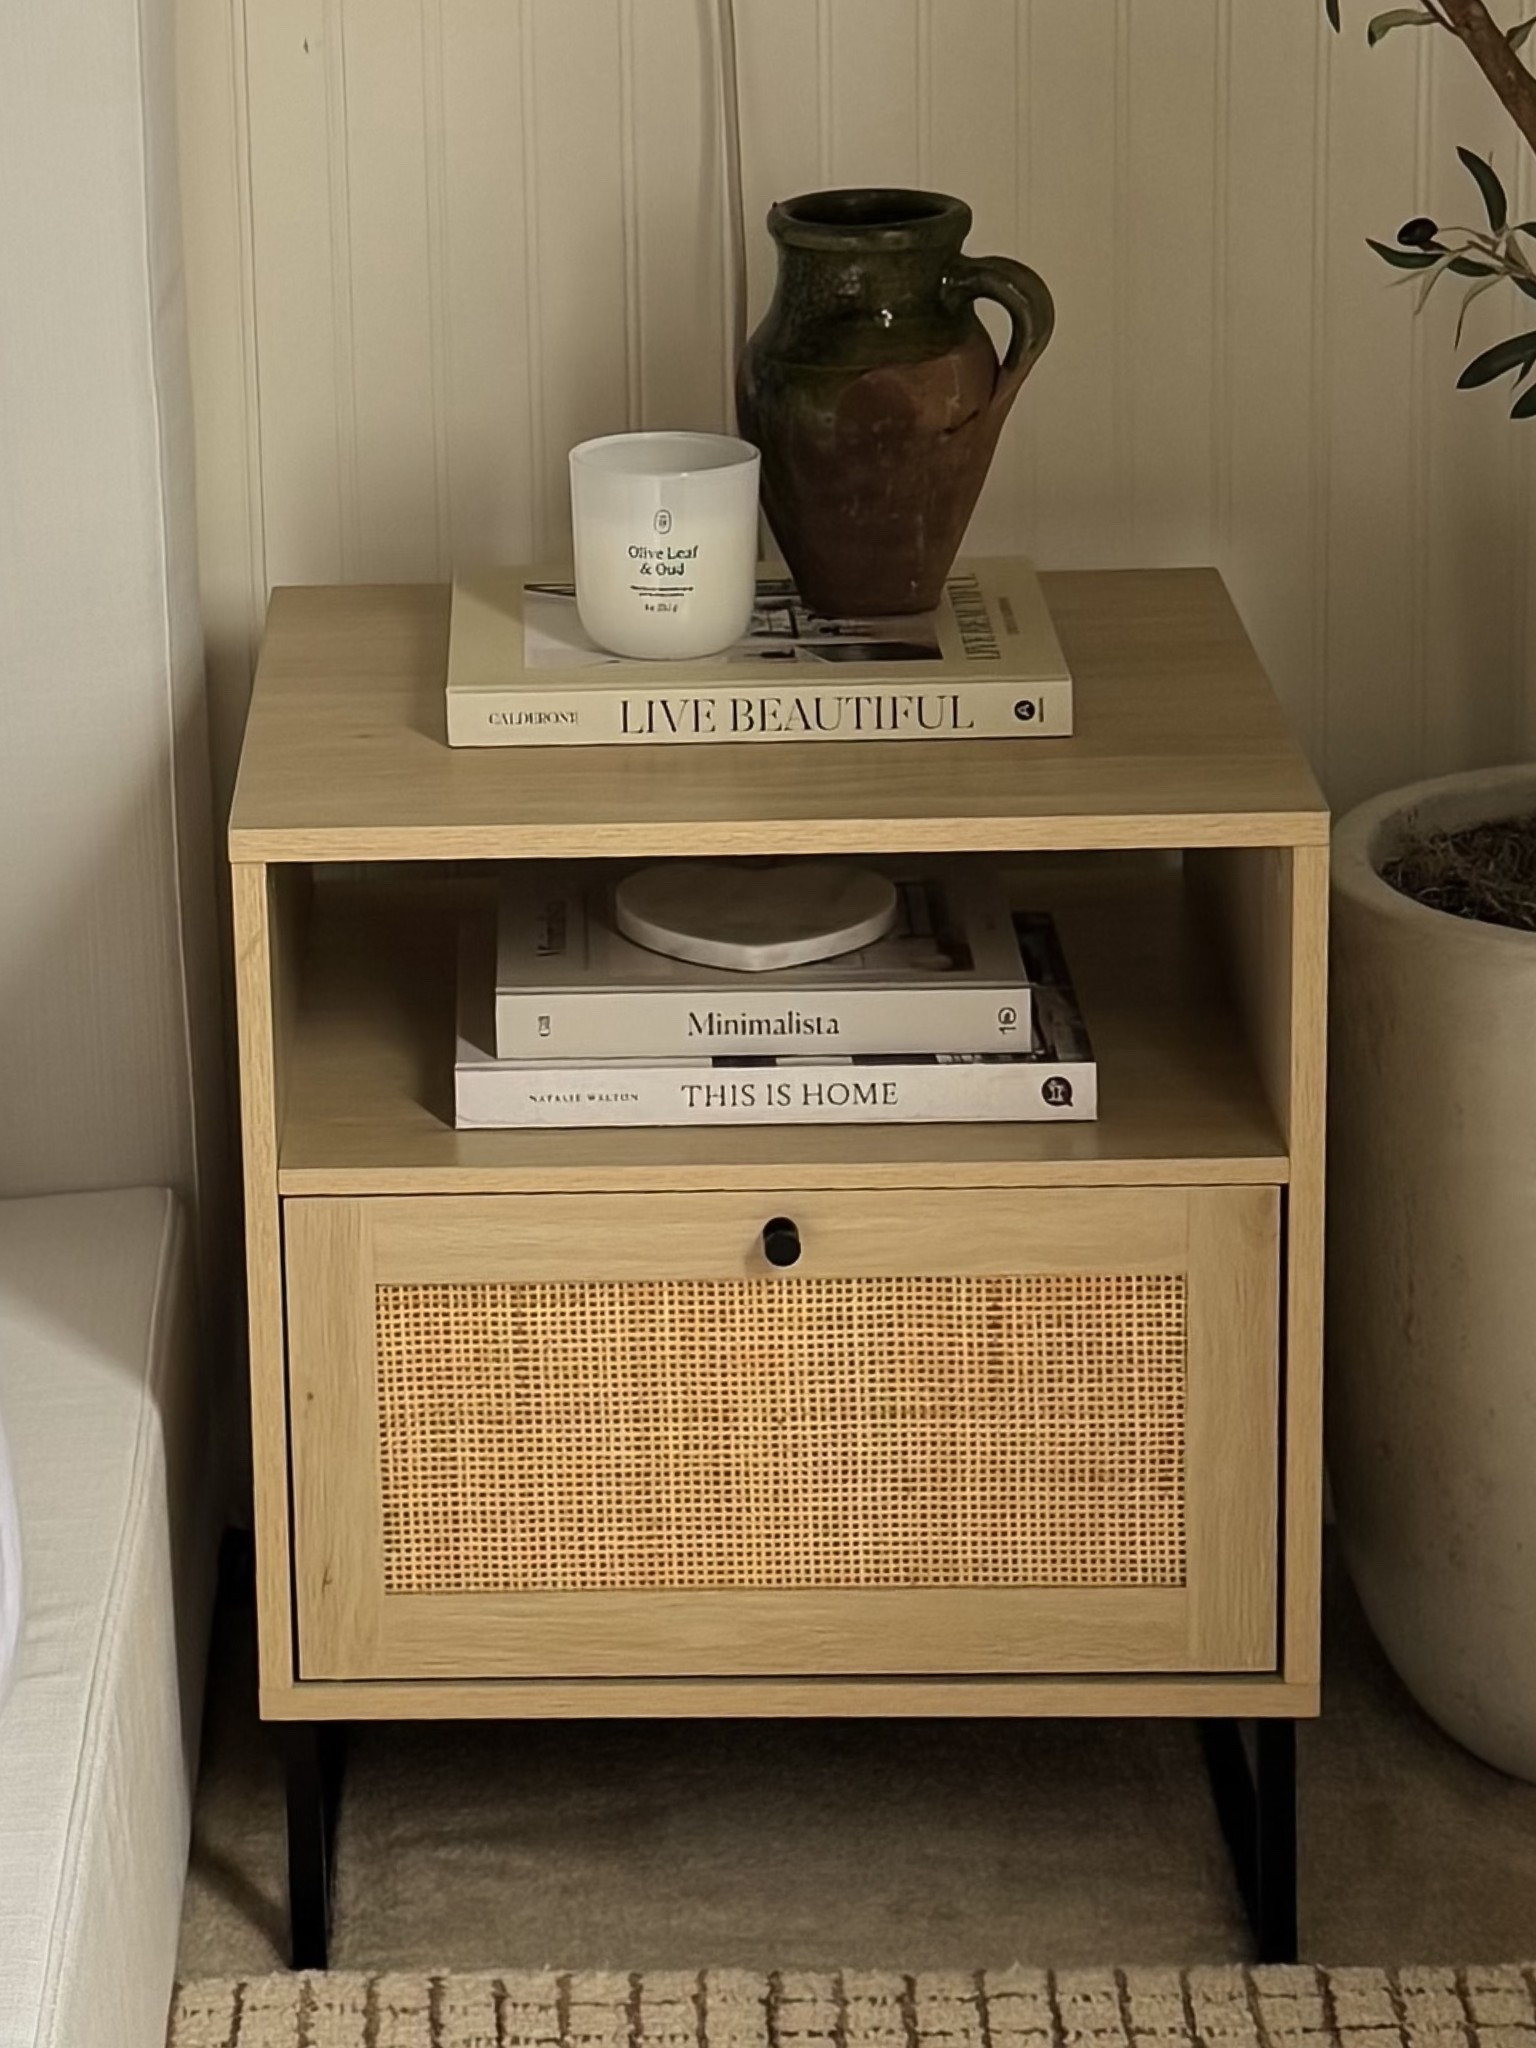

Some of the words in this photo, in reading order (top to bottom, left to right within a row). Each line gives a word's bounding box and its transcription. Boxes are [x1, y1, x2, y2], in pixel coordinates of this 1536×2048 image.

[628, 545, 664, 559] Olive
[667, 545, 699, 559] Leaf
[640, 562, 652, 576] &
[620, 698, 716, 734] LIVE
[729, 694, 975, 733] BEAUTIFUL
[687, 1010, 840, 1037] Minimalista
[680, 1083, 756, 1108] THIS
[766, 1082, 792, 1107] IS
[801, 1081, 899, 1107] HOME
